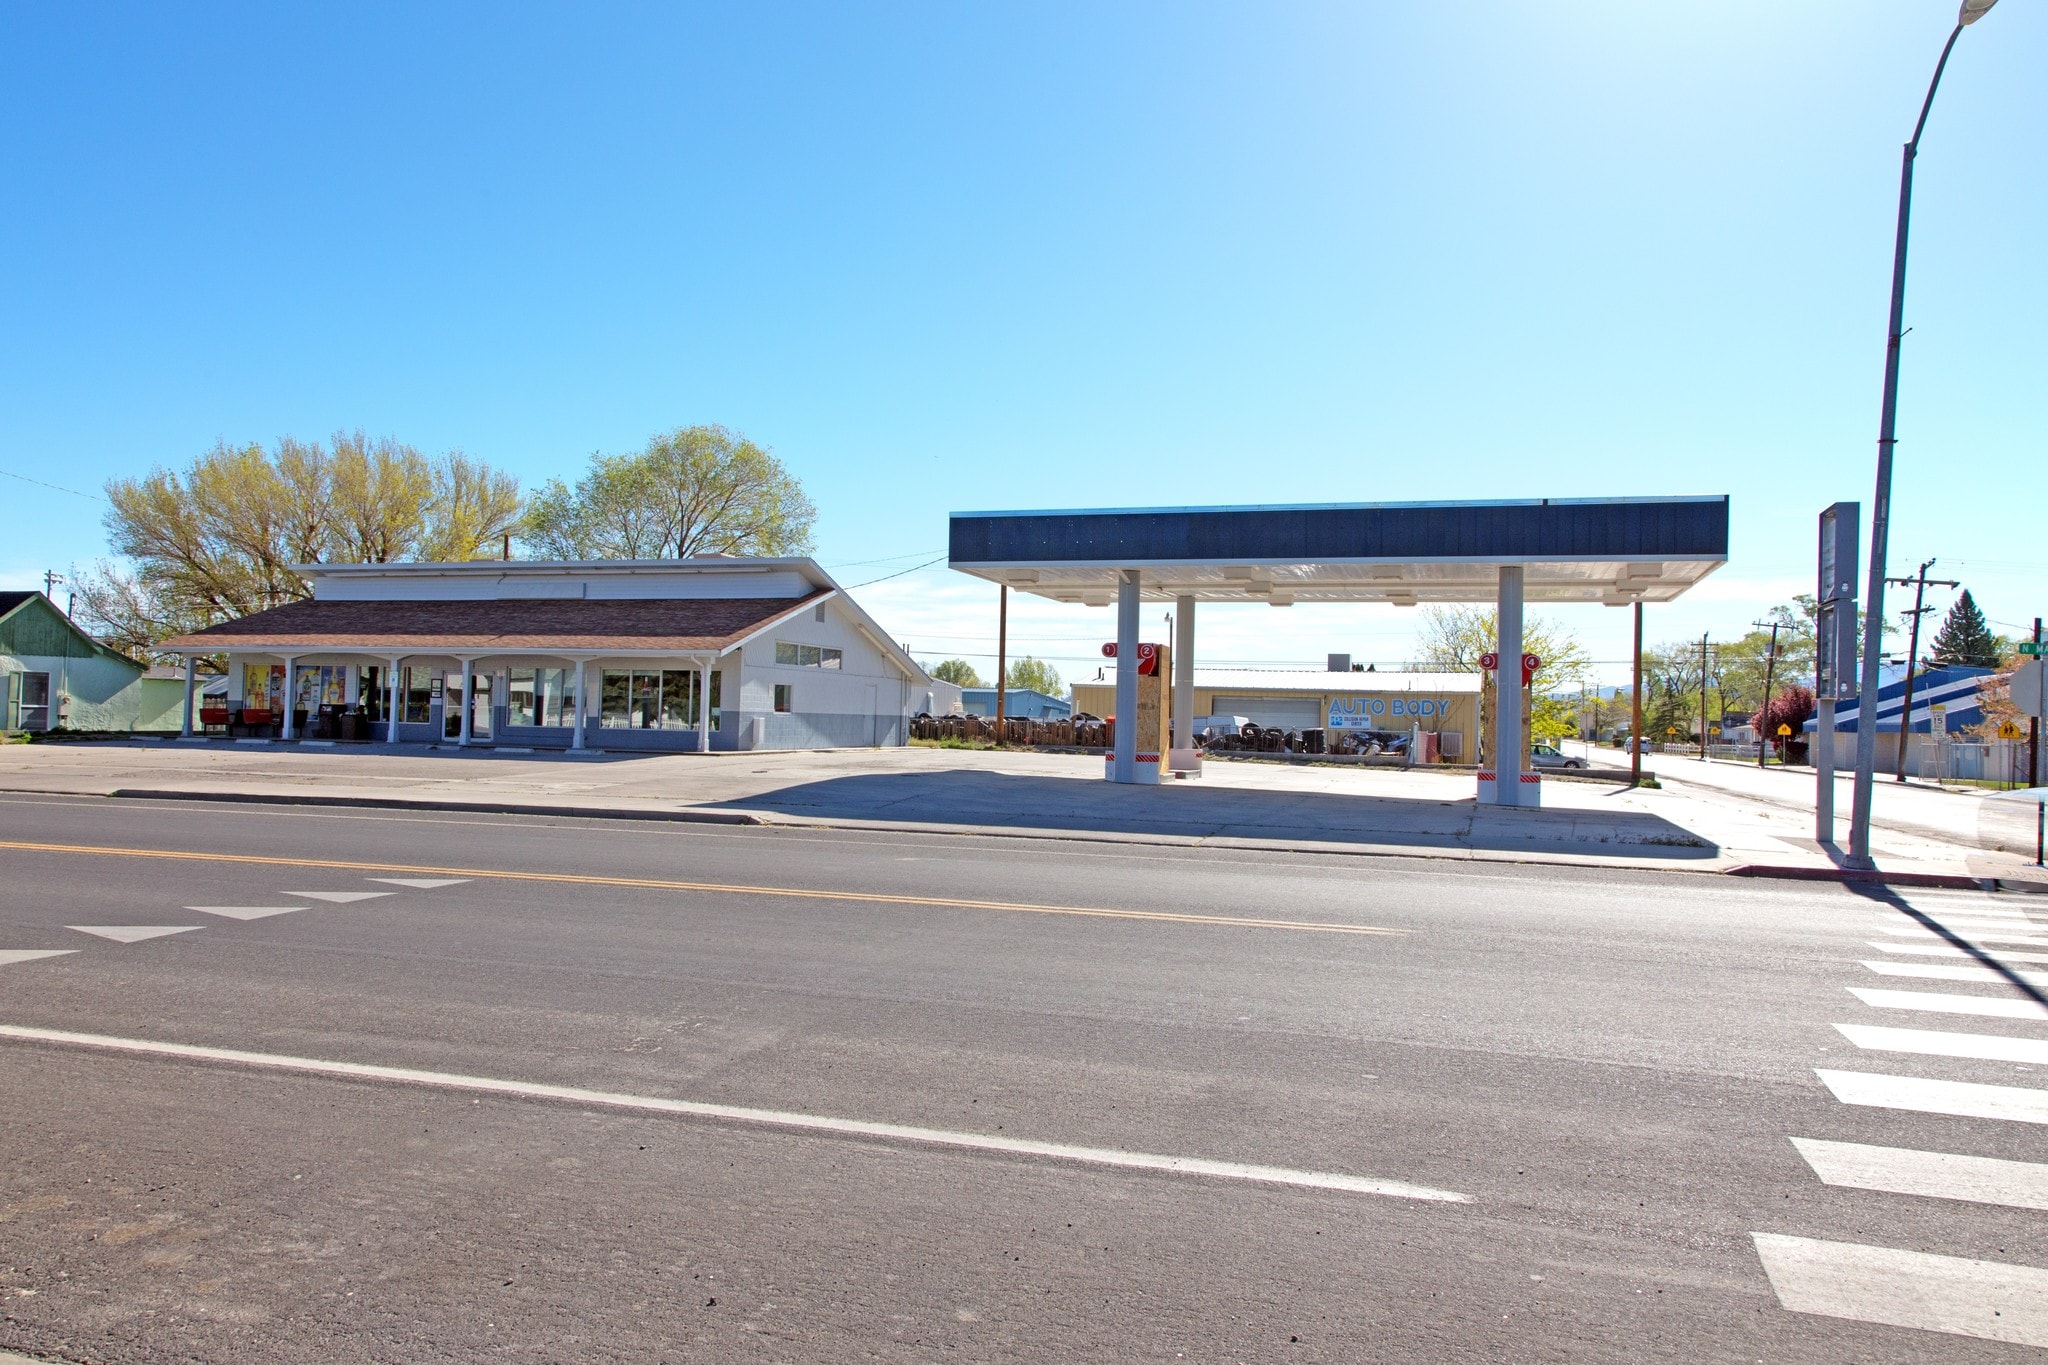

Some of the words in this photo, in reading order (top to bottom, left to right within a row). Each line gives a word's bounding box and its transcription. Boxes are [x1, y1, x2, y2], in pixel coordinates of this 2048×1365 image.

[2022, 644, 2029, 653] N
[1483, 656, 1490, 664] 3
[1528, 658, 1535, 666] 4
[1328, 697, 1386, 716] AUTO
[1391, 698, 1450, 717] BODY
